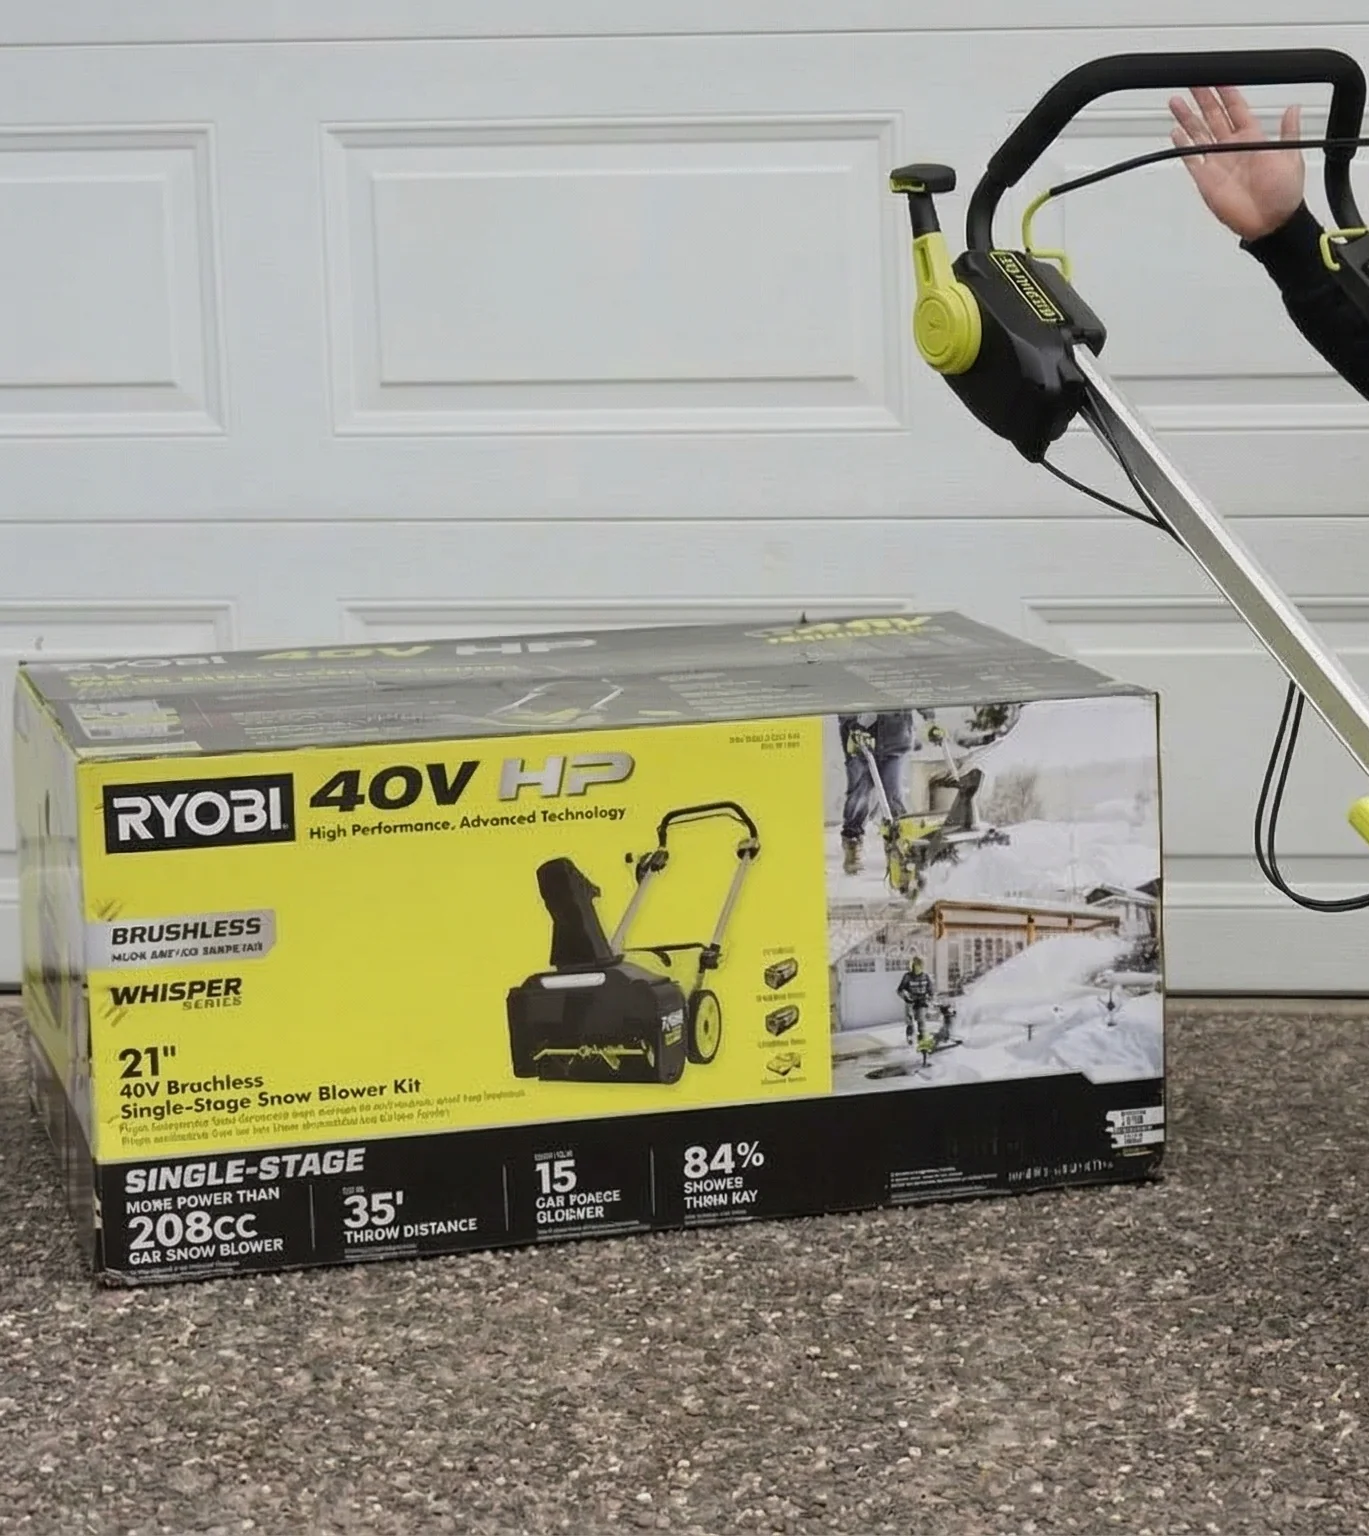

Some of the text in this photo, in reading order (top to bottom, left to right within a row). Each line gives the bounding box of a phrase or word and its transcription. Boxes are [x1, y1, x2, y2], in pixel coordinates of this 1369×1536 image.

[309, 751, 636, 812] 40V HP
[113, 787, 283, 841] RYOBI
[309, 805, 626, 842] High Performance, Advanced Technology
[111, 917, 262, 946] BRUSHLESS
[110, 977, 243, 1006] WHISPER
[119, 1045, 176, 1079] 21"
[120, 1081, 160, 1099] 40V
[121, 1096, 251, 1121] Single-Stage
[258, 1090, 312, 1107] Snow
[318, 1083, 388, 1101] Blower
[394, 1077, 422, 1094] Kit
[125, 1147, 366, 1194] SINGLE-STAGE
[535, 1159, 577, 1194] 15
[683, 1140, 765, 1179] 84%
[177, 1191, 233, 1209] POWER
[236, 1186, 280, 1203] THAN
[732, 1189, 758, 1204] KAY
[344, 1217, 478, 1243] THROW DISTANCE
[165, 1245, 216, 1262] SNOW
[219, 1238, 284, 1256] BLOWER
